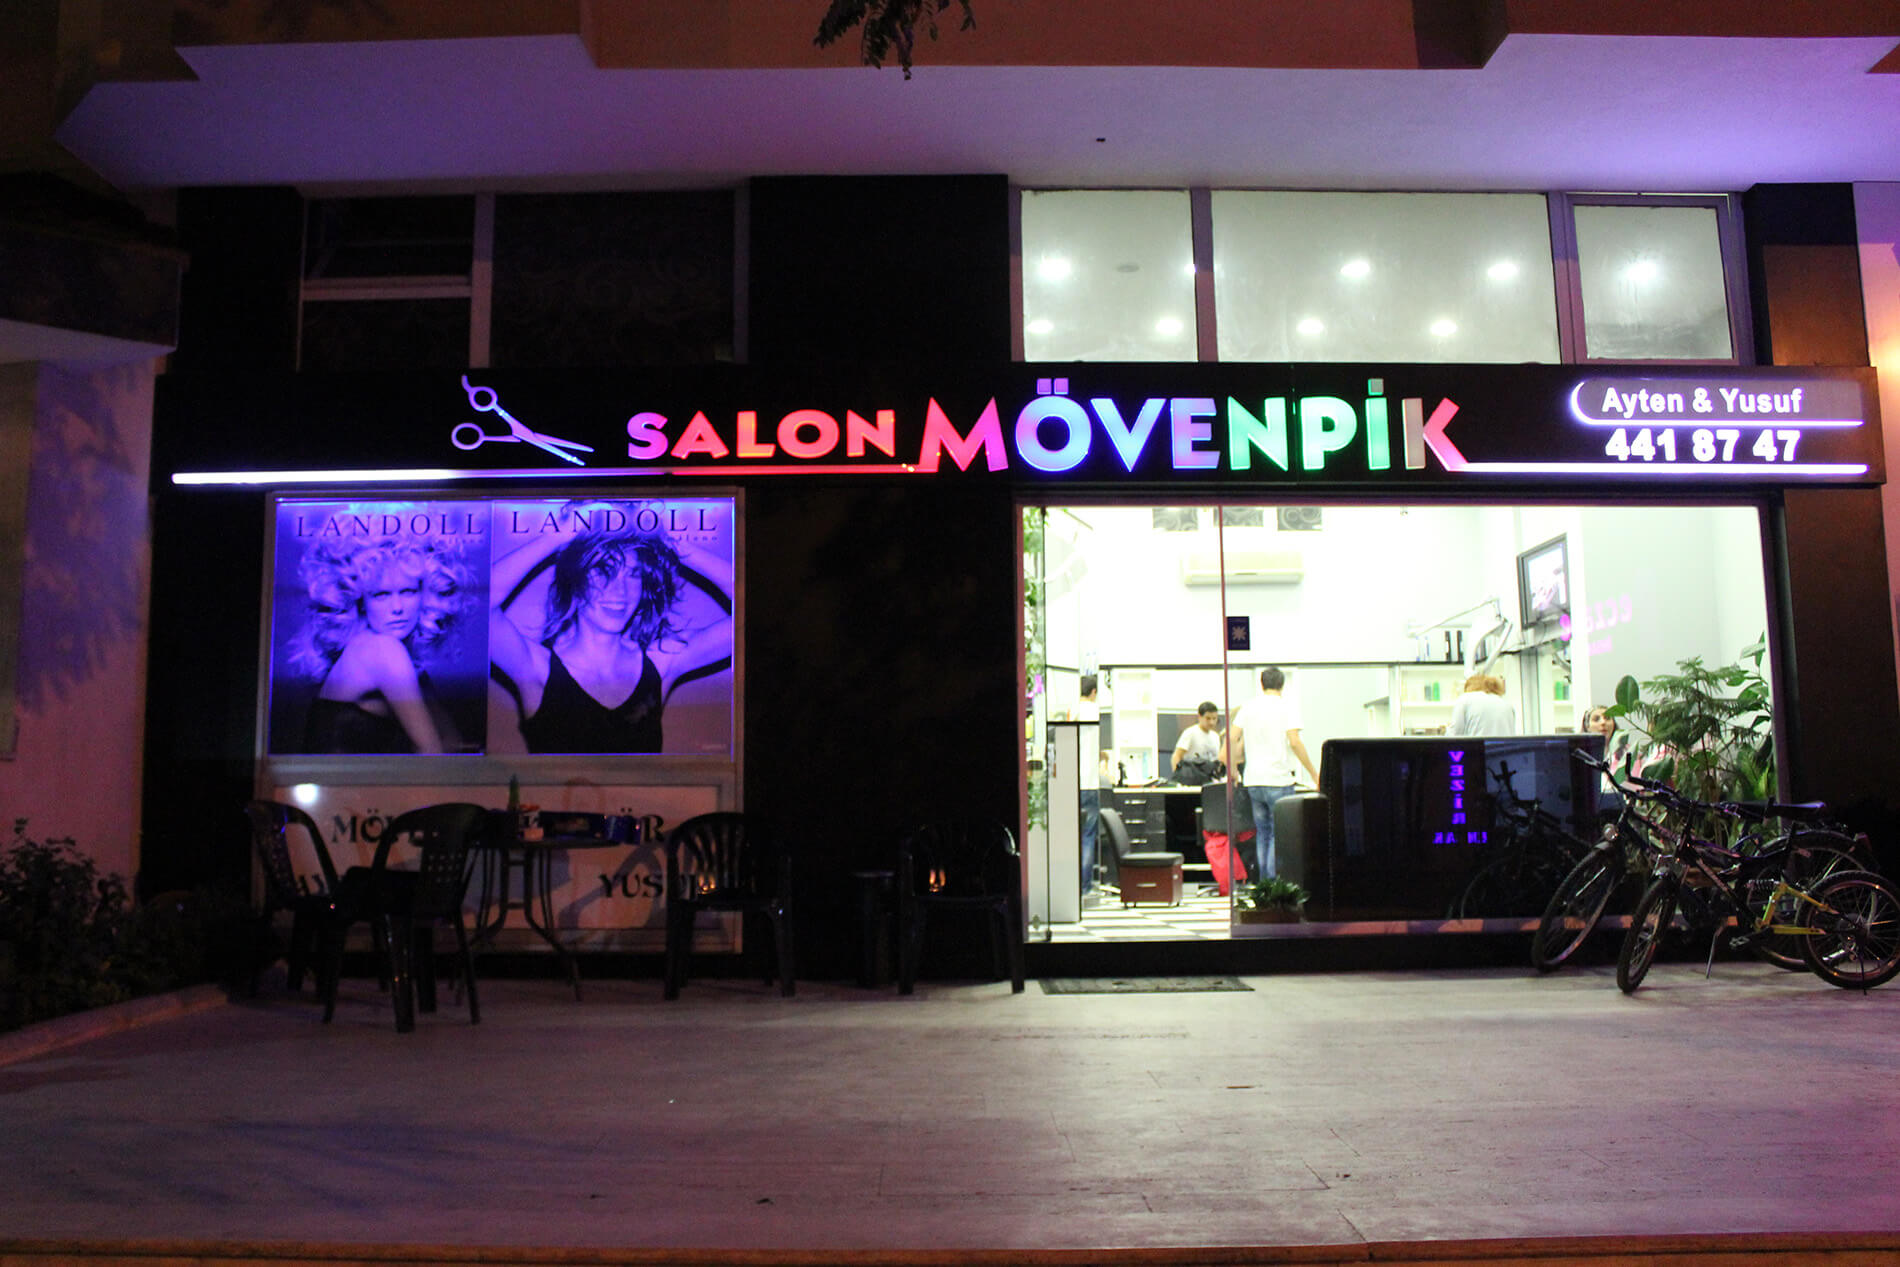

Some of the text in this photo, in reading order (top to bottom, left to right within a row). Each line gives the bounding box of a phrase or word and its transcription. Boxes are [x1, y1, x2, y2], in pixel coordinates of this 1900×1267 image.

[1601, 387, 1803, 418] Ayten & Yusuf
[627, 377, 1469, 473] SALON MÖVENPİK
[1605, 428, 1801, 462] 441 87 47
[297, 513, 486, 537] LANDOLL
[511, 508, 718, 534] LANDOLL
